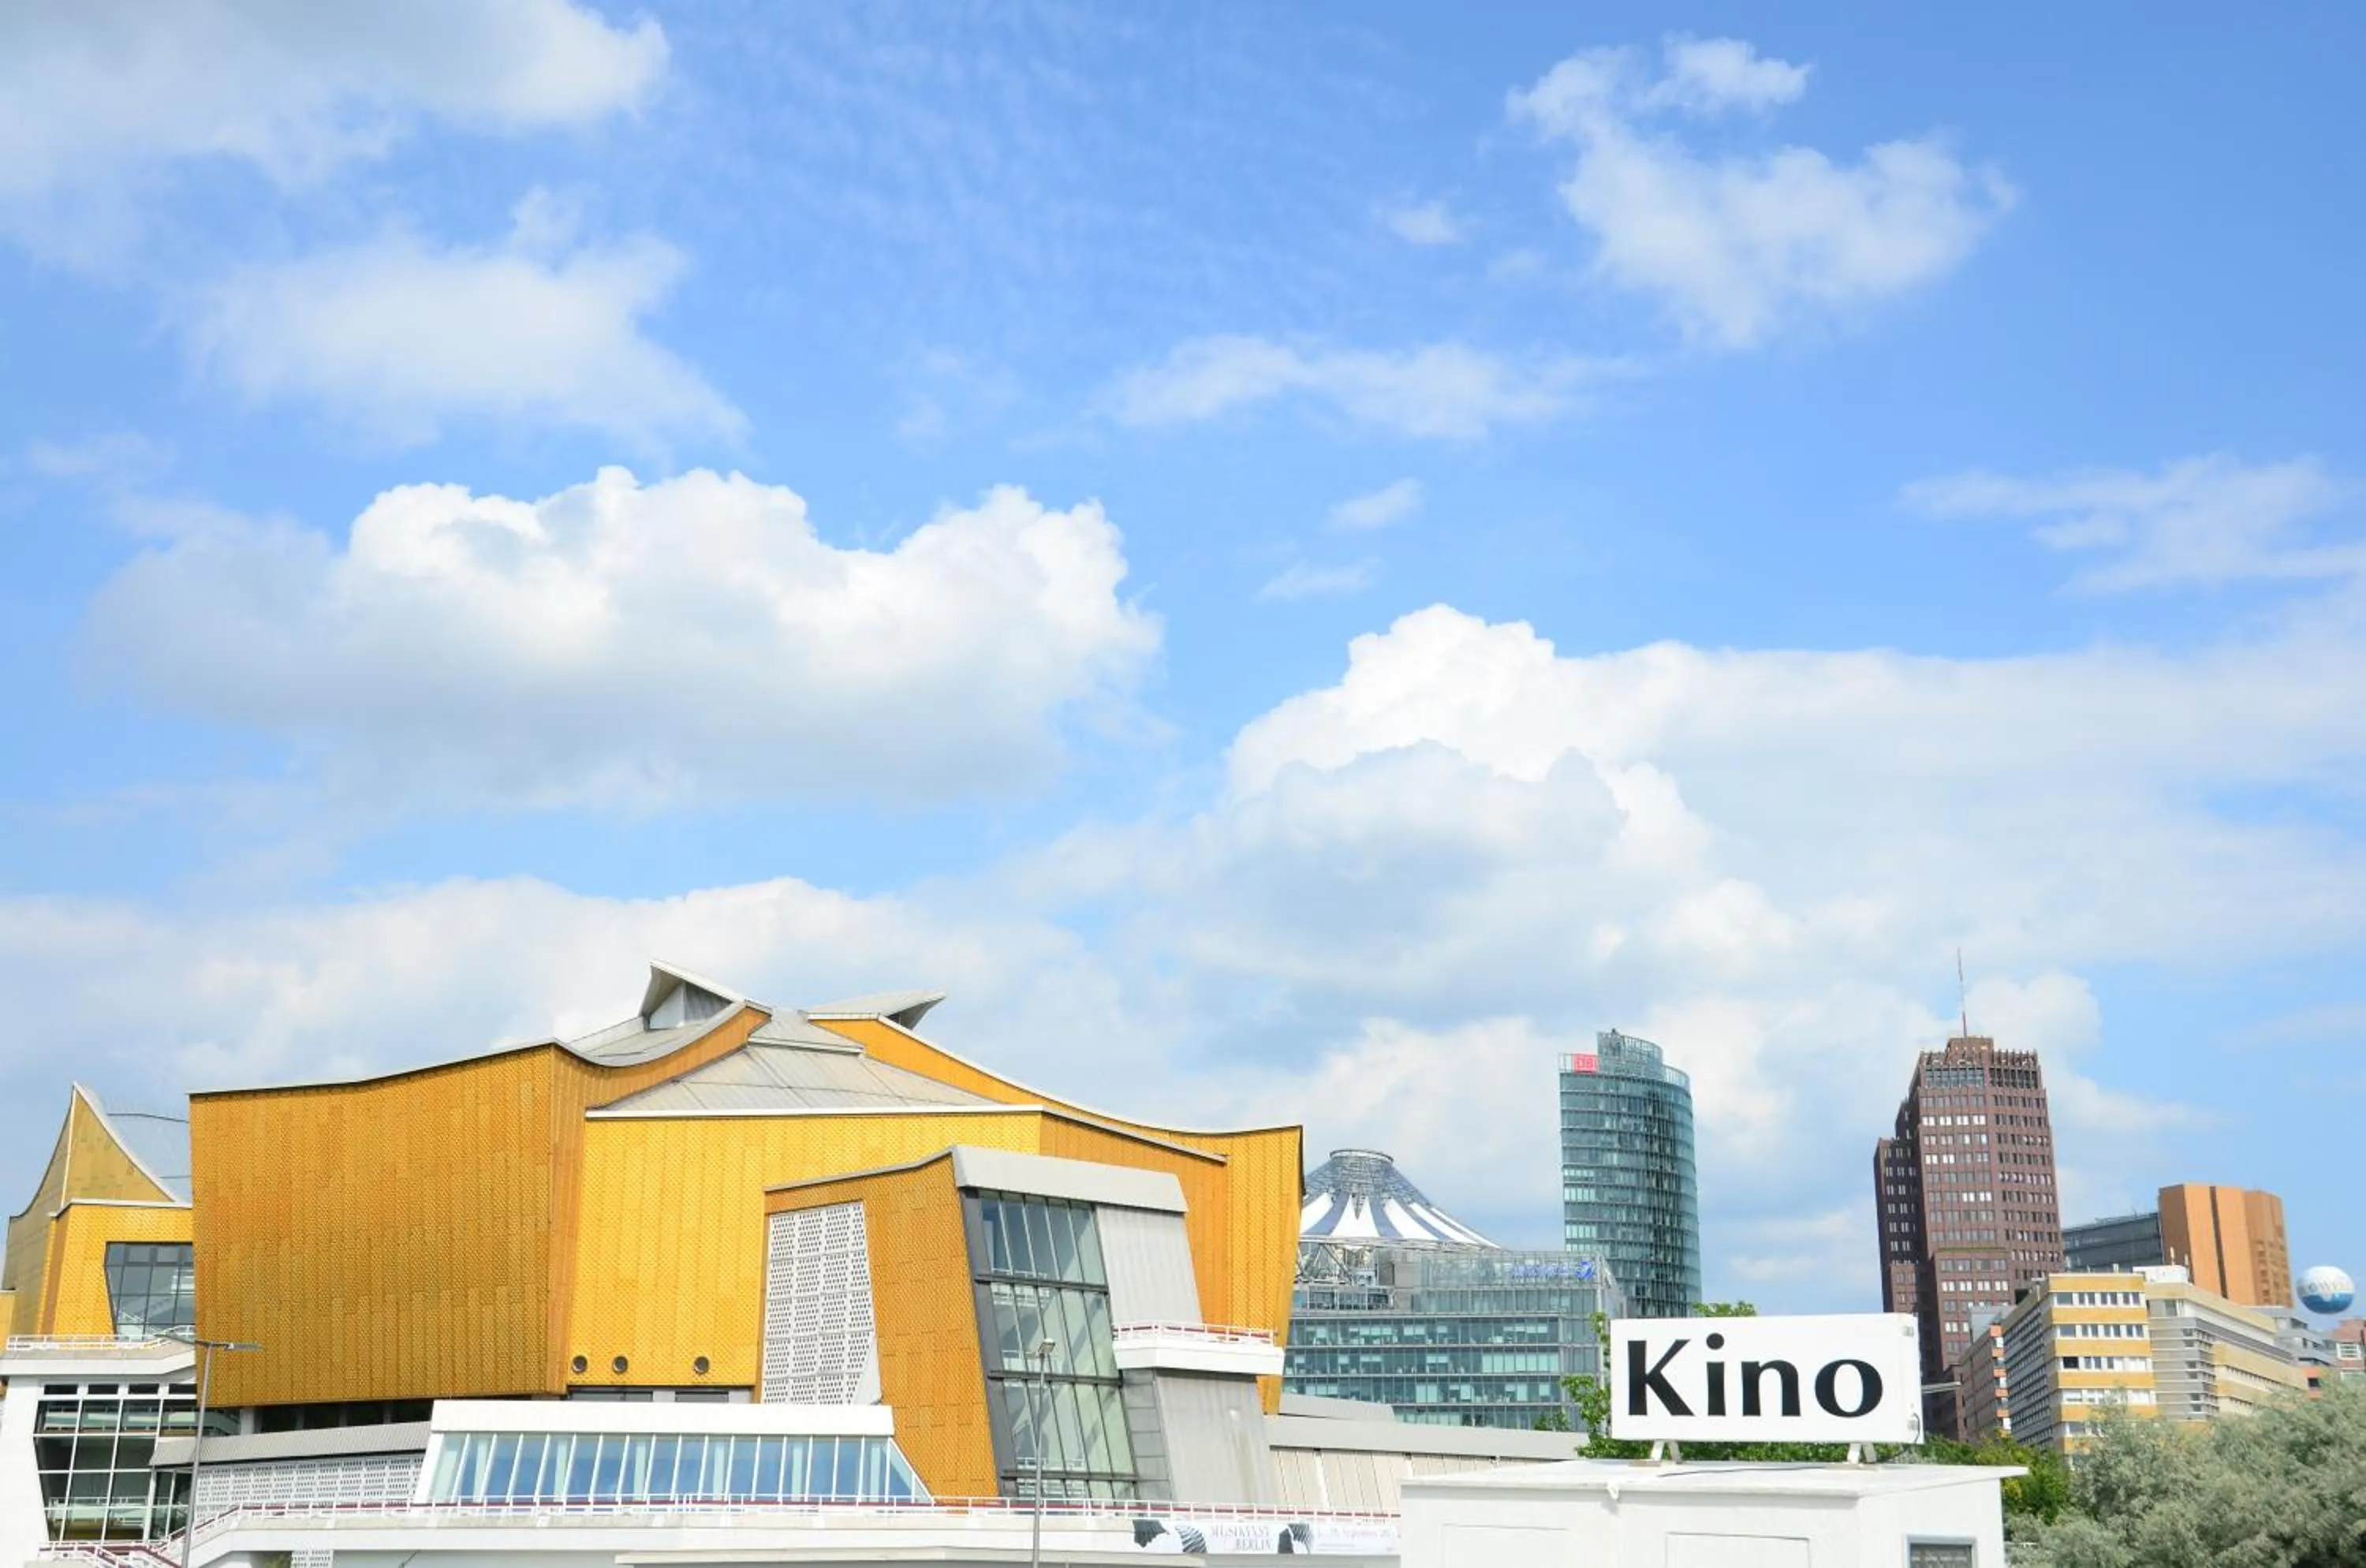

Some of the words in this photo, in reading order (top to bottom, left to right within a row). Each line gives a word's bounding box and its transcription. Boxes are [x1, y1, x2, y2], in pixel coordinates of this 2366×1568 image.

[1577, 1057, 1594, 1070] DB
[1628, 1333, 1883, 1417] Kino
[1236, 1538, 1271, 1551] BERLIN
